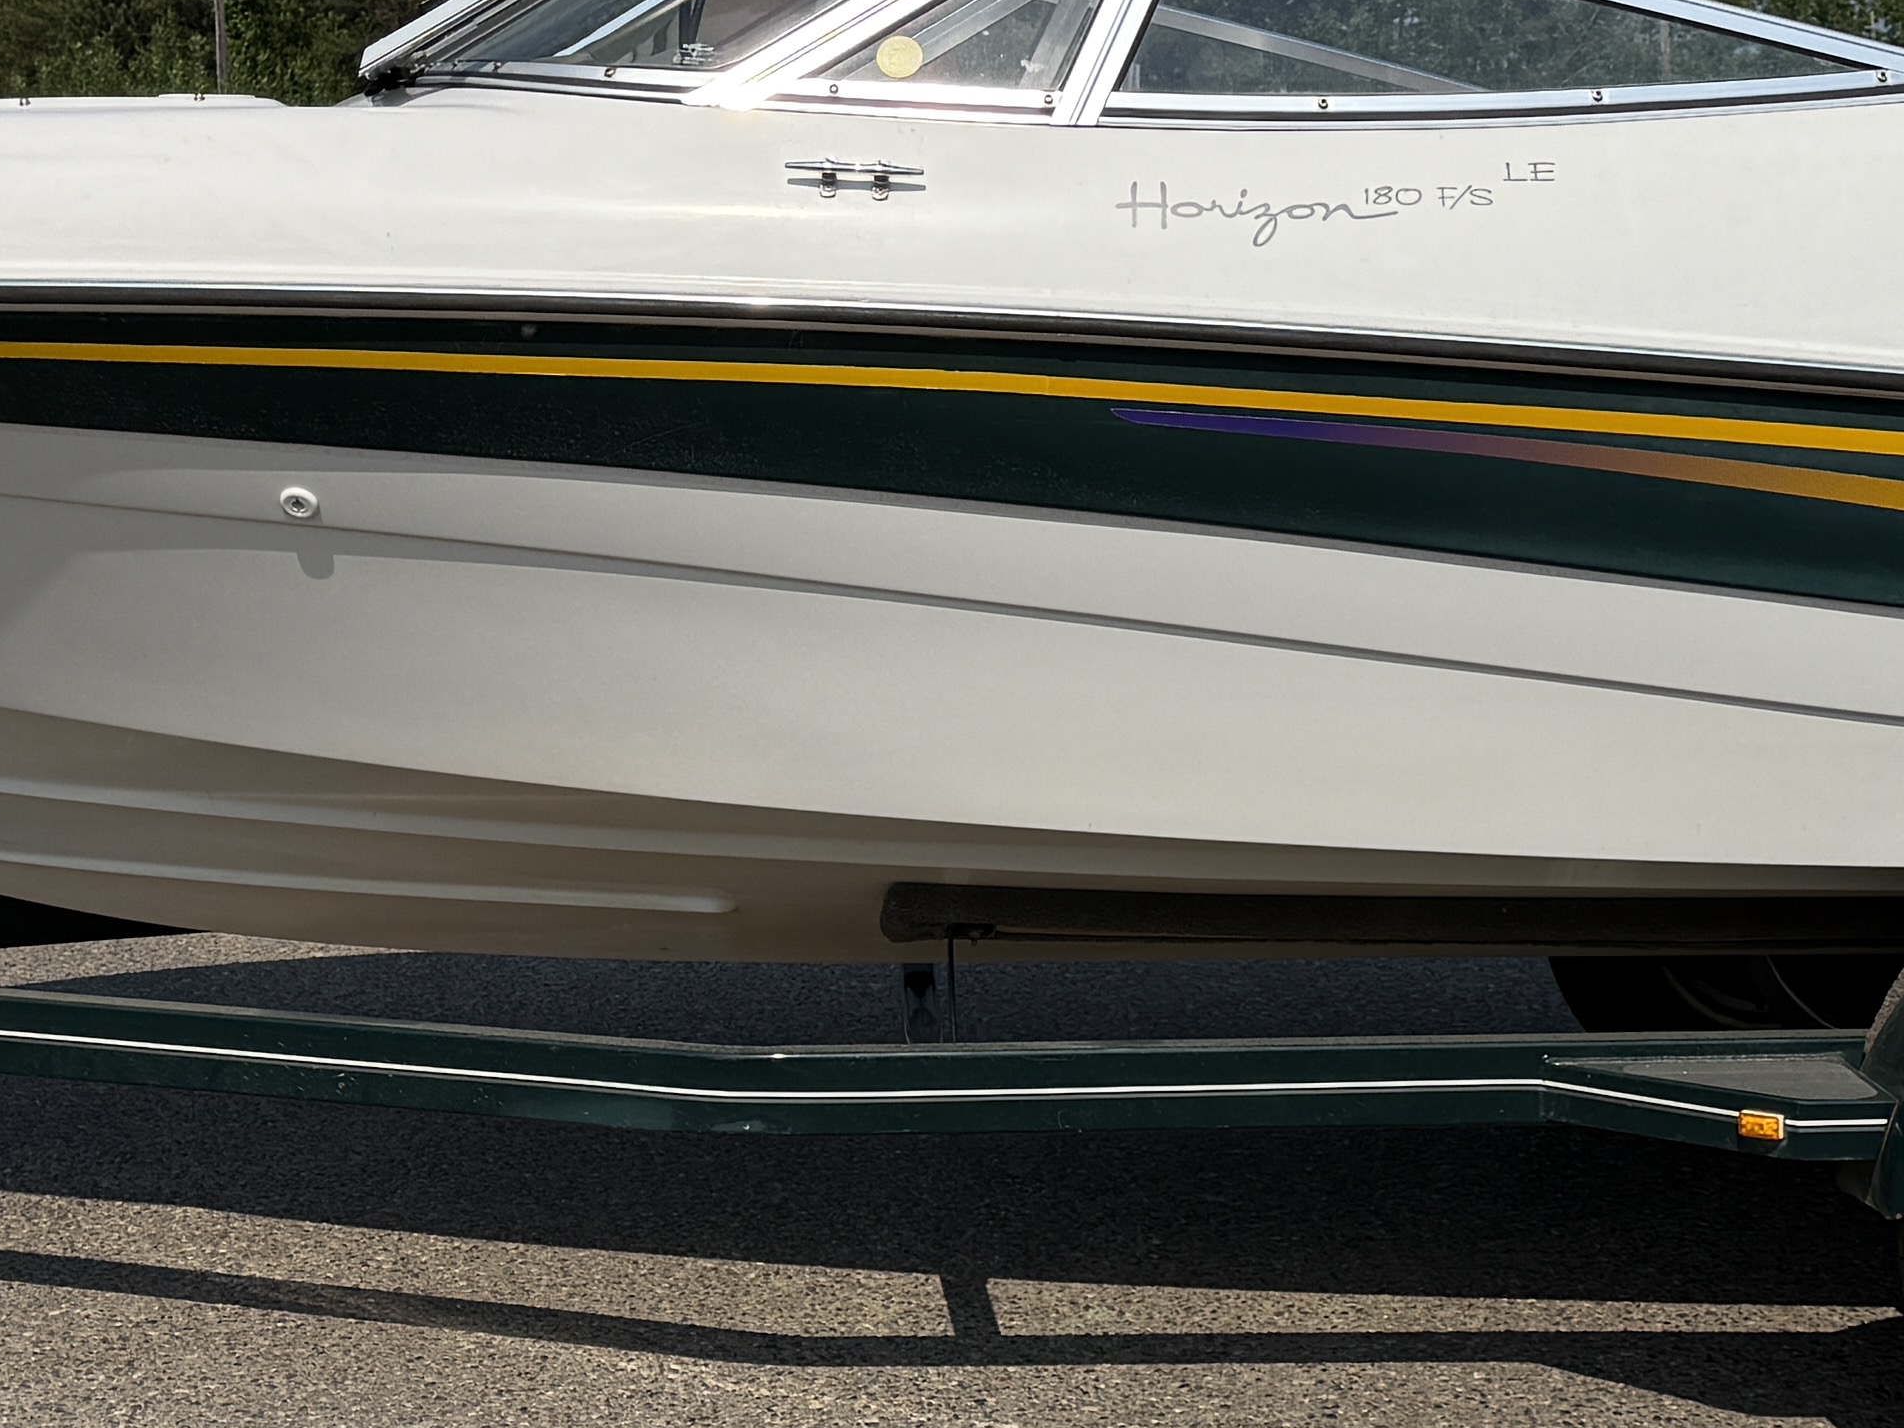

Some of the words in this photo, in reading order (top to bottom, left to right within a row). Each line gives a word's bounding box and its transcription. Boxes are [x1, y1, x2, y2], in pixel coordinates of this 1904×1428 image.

[1115, 180, 1399, 247] Horizon
[1364, 185, 1423, 206] 180
[1437, 184, 1494, 210] F/S
[1502, 161, 1556, 182] LE
